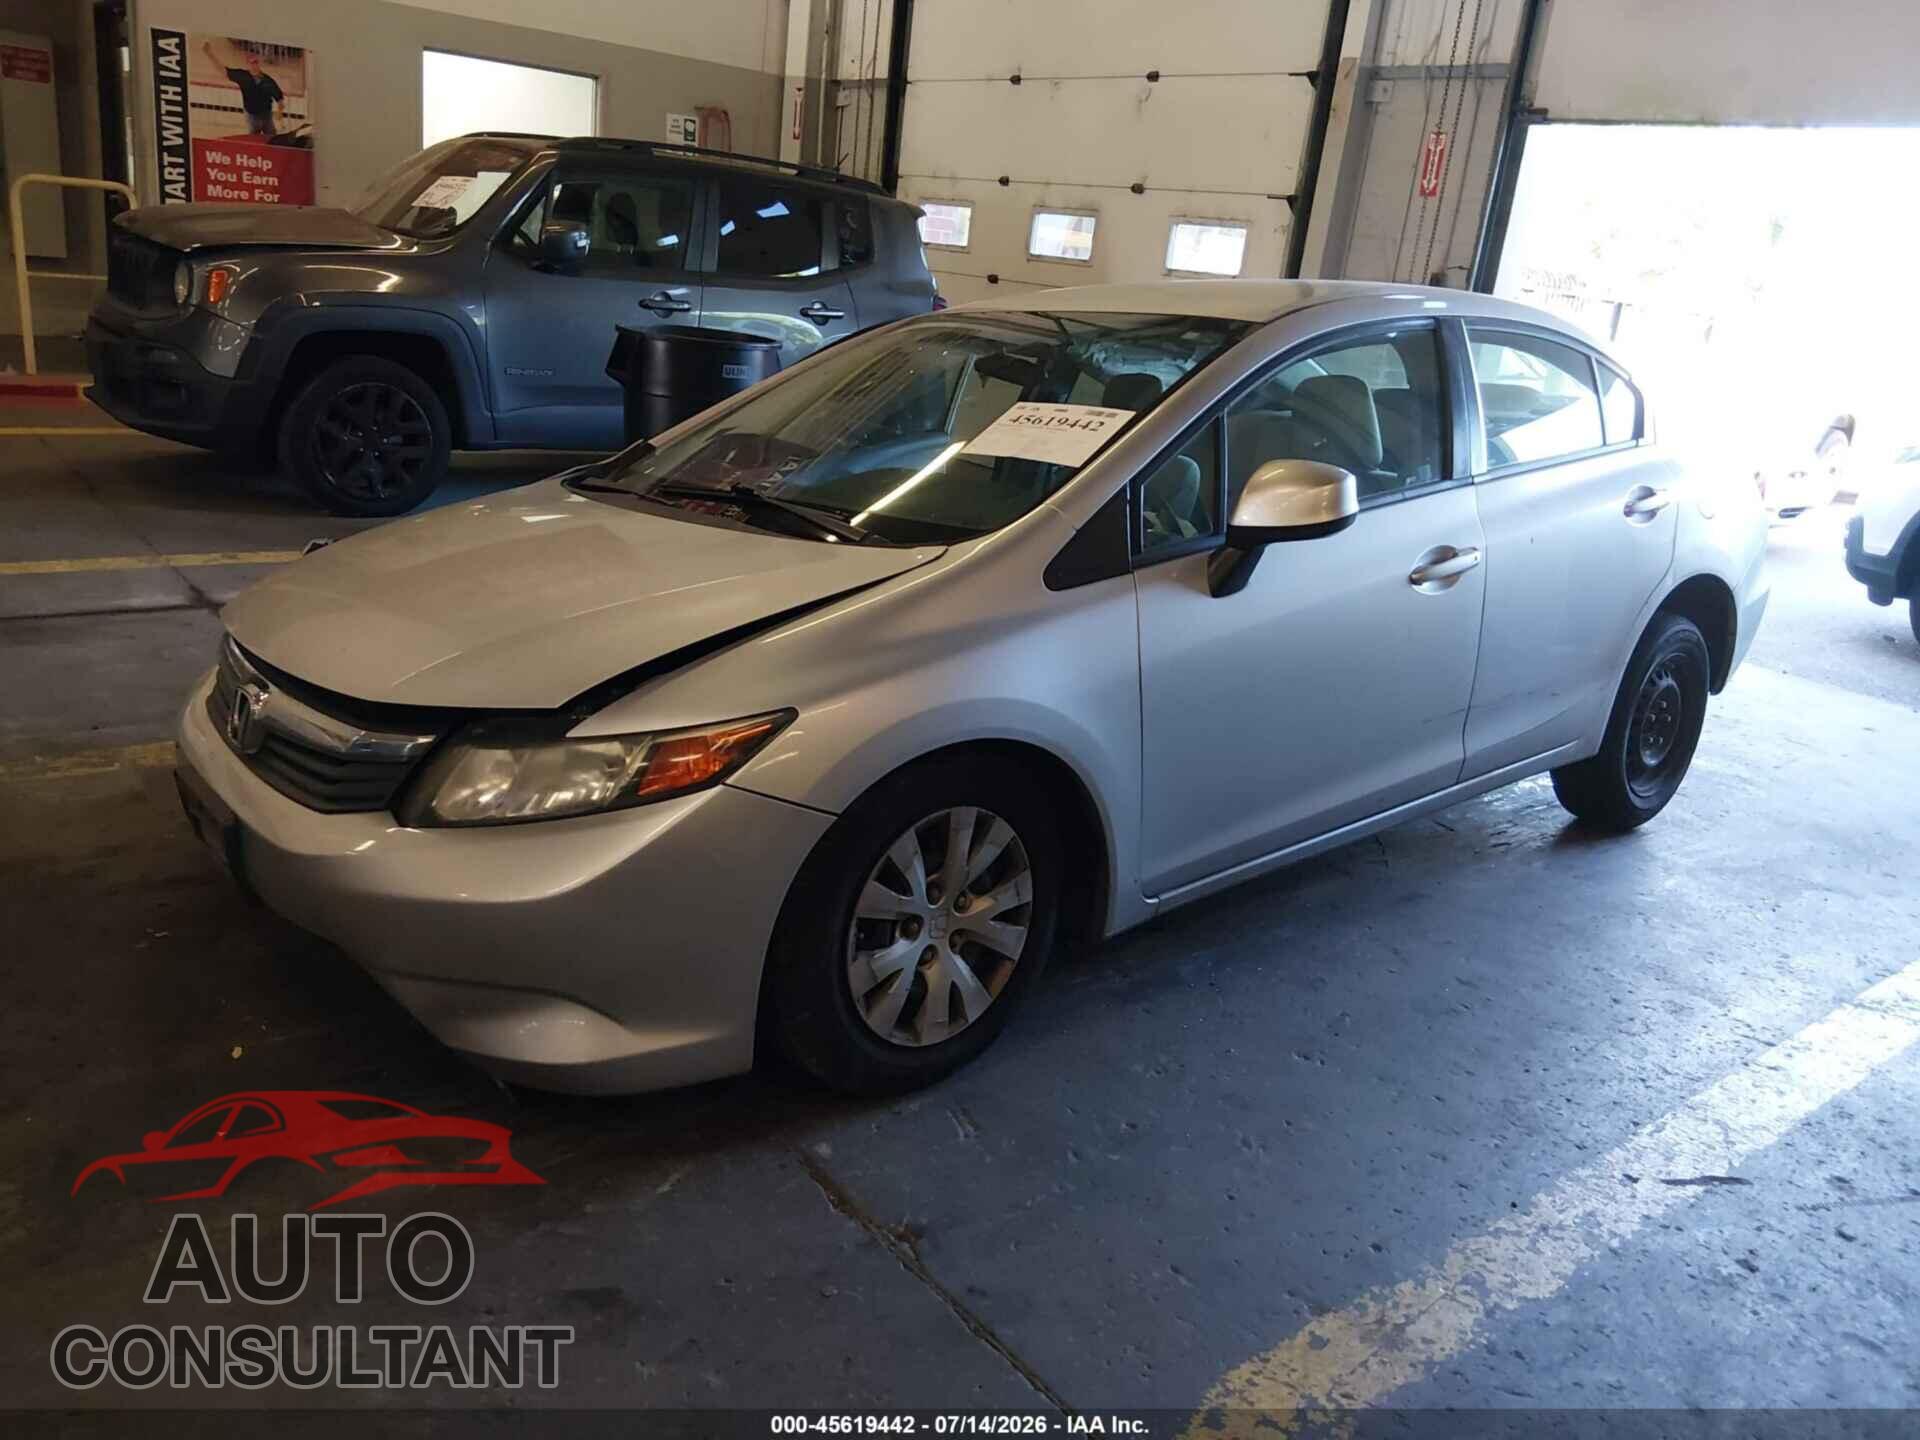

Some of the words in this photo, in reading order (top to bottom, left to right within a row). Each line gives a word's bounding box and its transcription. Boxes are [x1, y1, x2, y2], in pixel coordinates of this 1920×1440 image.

[158, 36, 181, 78] IAA
[160, 85, 183, 146] WITH
[205, 150, 231, 165] We
[235, 153, 273, 171] Help
[206, 167, 237, 182] You
[242, 171, 279, 186] Earn
[206, 184, 249, 200] More
[254, 189, 280, 203] For
[1008, 413, 1105, 432] 45619442
